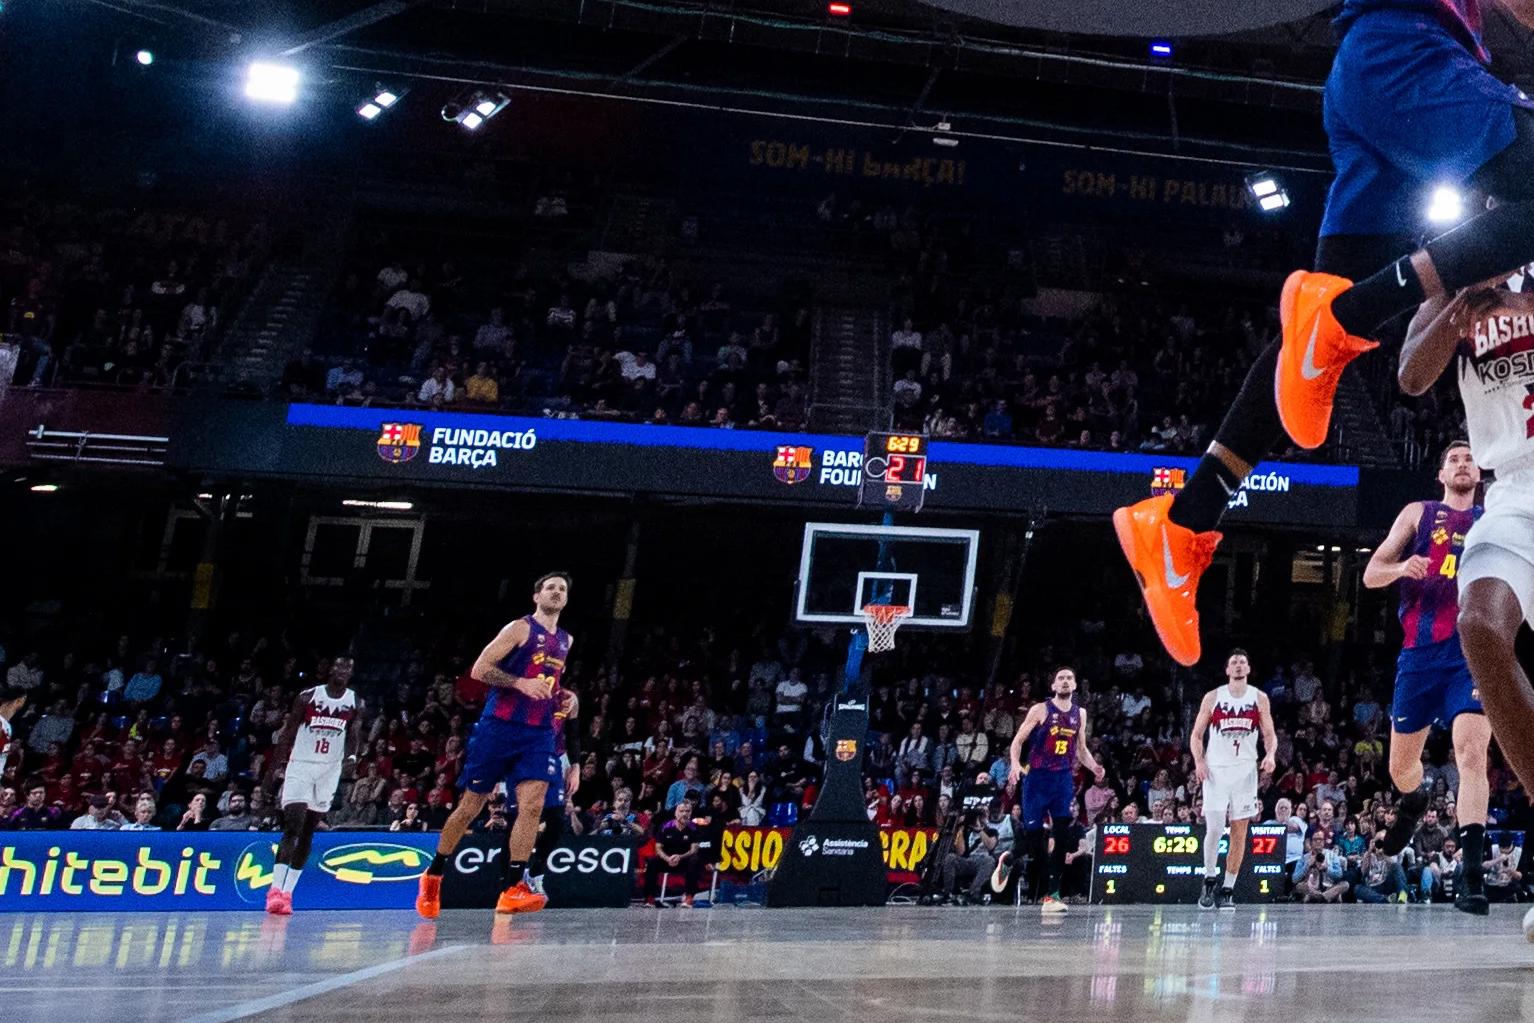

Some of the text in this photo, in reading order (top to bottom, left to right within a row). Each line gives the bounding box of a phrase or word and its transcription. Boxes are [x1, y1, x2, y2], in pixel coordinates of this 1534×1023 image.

[432, 427, 537, 450] FUNDACIÓ
[428, 445, 498, 469] BARÇA
[888, 455, 926, 482] 21
[1054, 739, 1069, 755] 13
[1103, 825, 1131, 835] LOCAL
[1164, 825, 1191, 835] TEMPS
[1103, 835, 1276, 855] 26 6:29 27
[0, 846, 221, 896] hitebit
[1098, 864, 1281, 875] FALTES TEMPS FALTES
[1105, 879, 1117, 895] 1
[1259, 879, 1270, 894] 1
